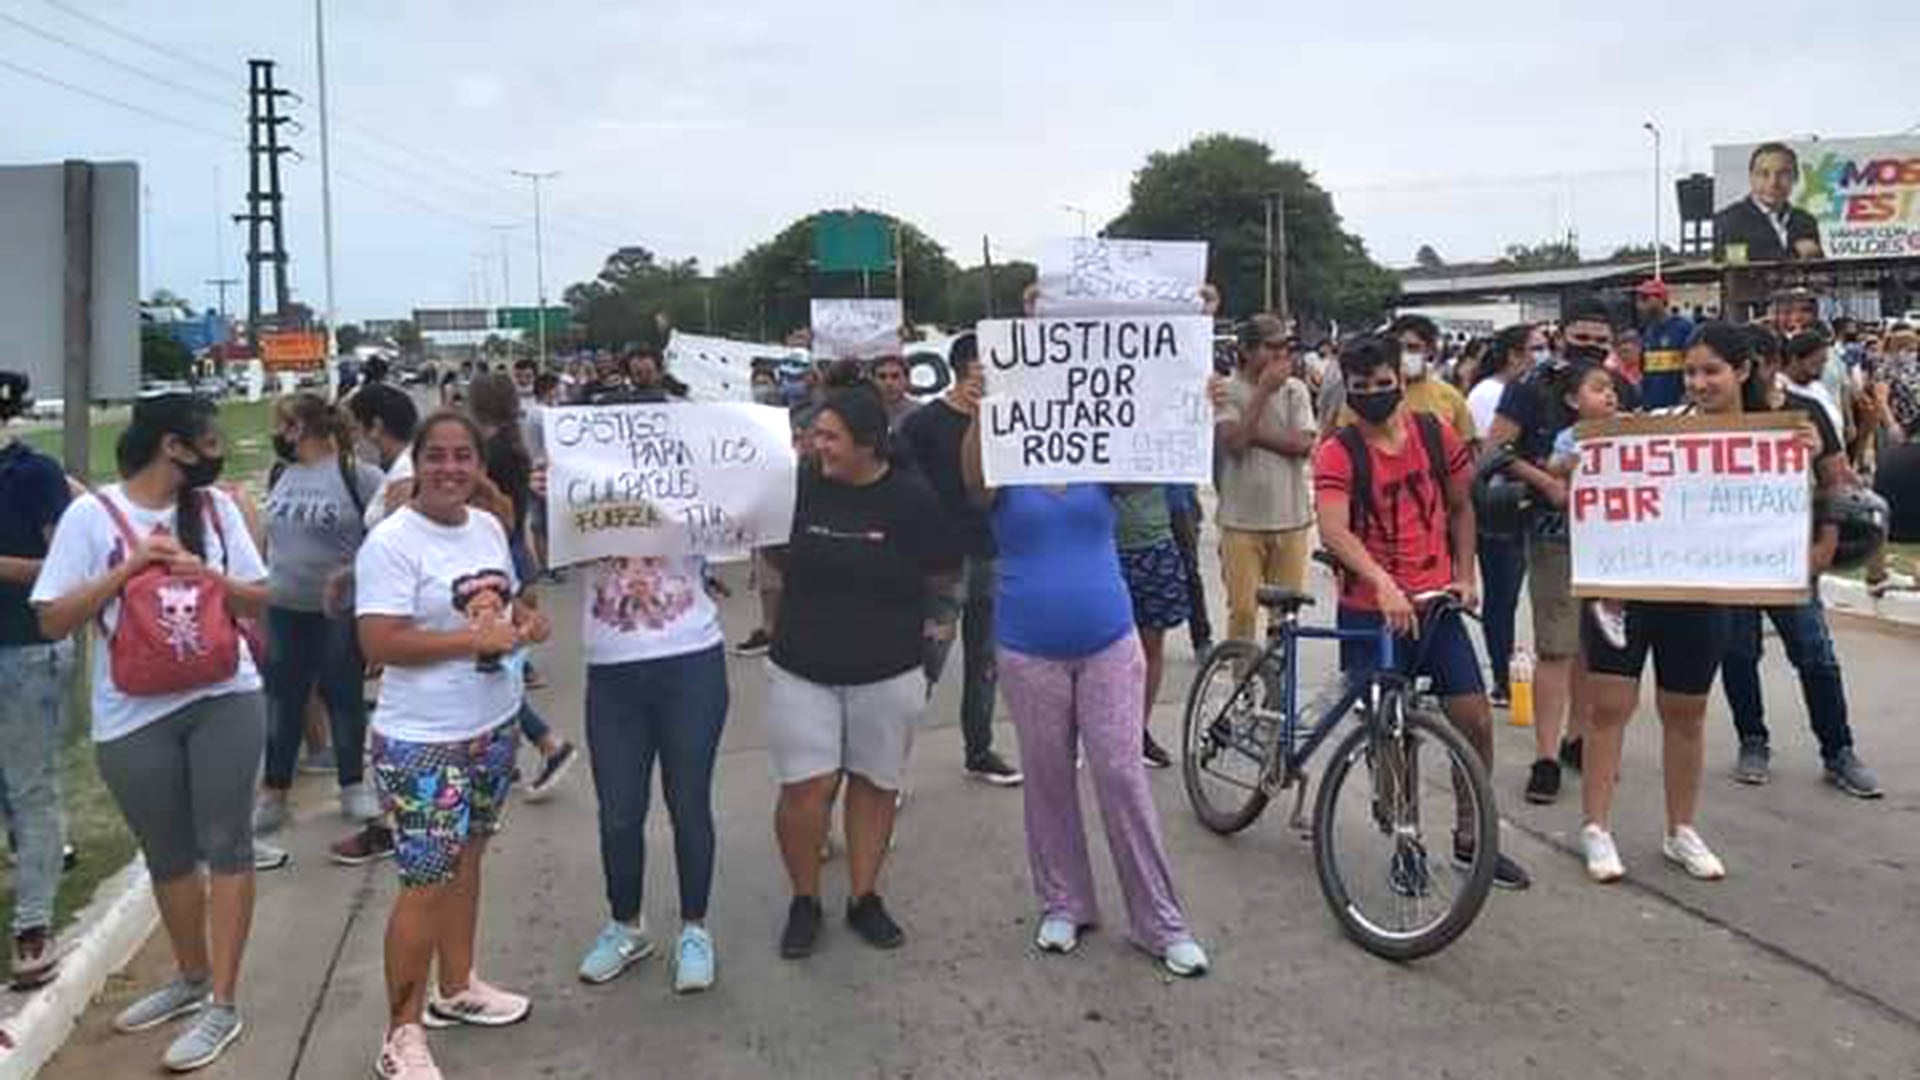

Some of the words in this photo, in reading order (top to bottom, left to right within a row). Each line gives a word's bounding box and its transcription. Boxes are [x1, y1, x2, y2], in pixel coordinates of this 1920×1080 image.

[990, 320, 1178, 370] JUSTICIA
[1067, 363, 1136, 405] POR
[557, 411, 668, 446] CASTIGO
[991, 398, 1136, 436] LAUTARO
[1023, 431, 1111, 466] ROSE
[1581, 437, 1806, 477] JUSTICIA
[1575, 486, 1661, 522] POR
